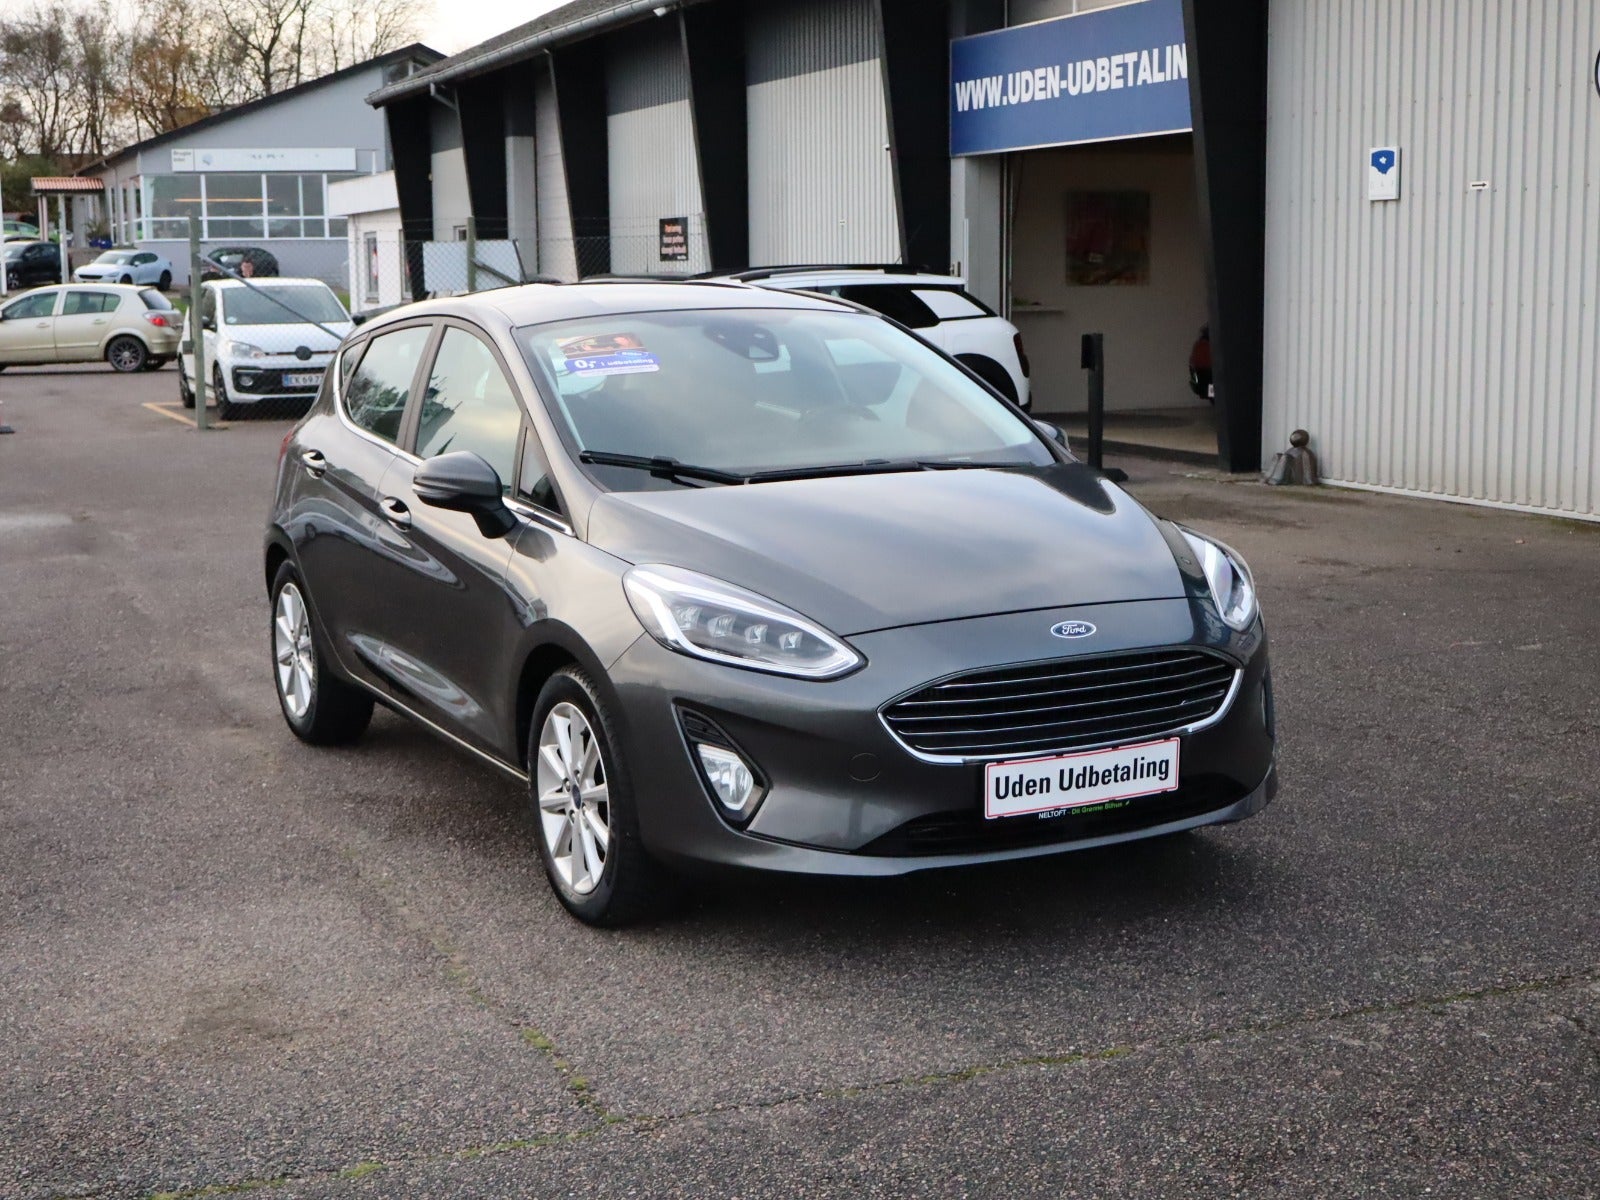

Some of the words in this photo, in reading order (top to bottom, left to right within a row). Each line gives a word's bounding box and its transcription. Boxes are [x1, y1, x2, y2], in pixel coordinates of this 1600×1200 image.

[955, 43, 1188, 112] WWW.UDEN-UDBETALIN
[1062, 624, 1087, 635] Ford
[995, 773, 1051, 800] Uden
[1059, 757, 1170, 791] Udbetaling
[1038, 809, 1067, 820] NELTOFT
